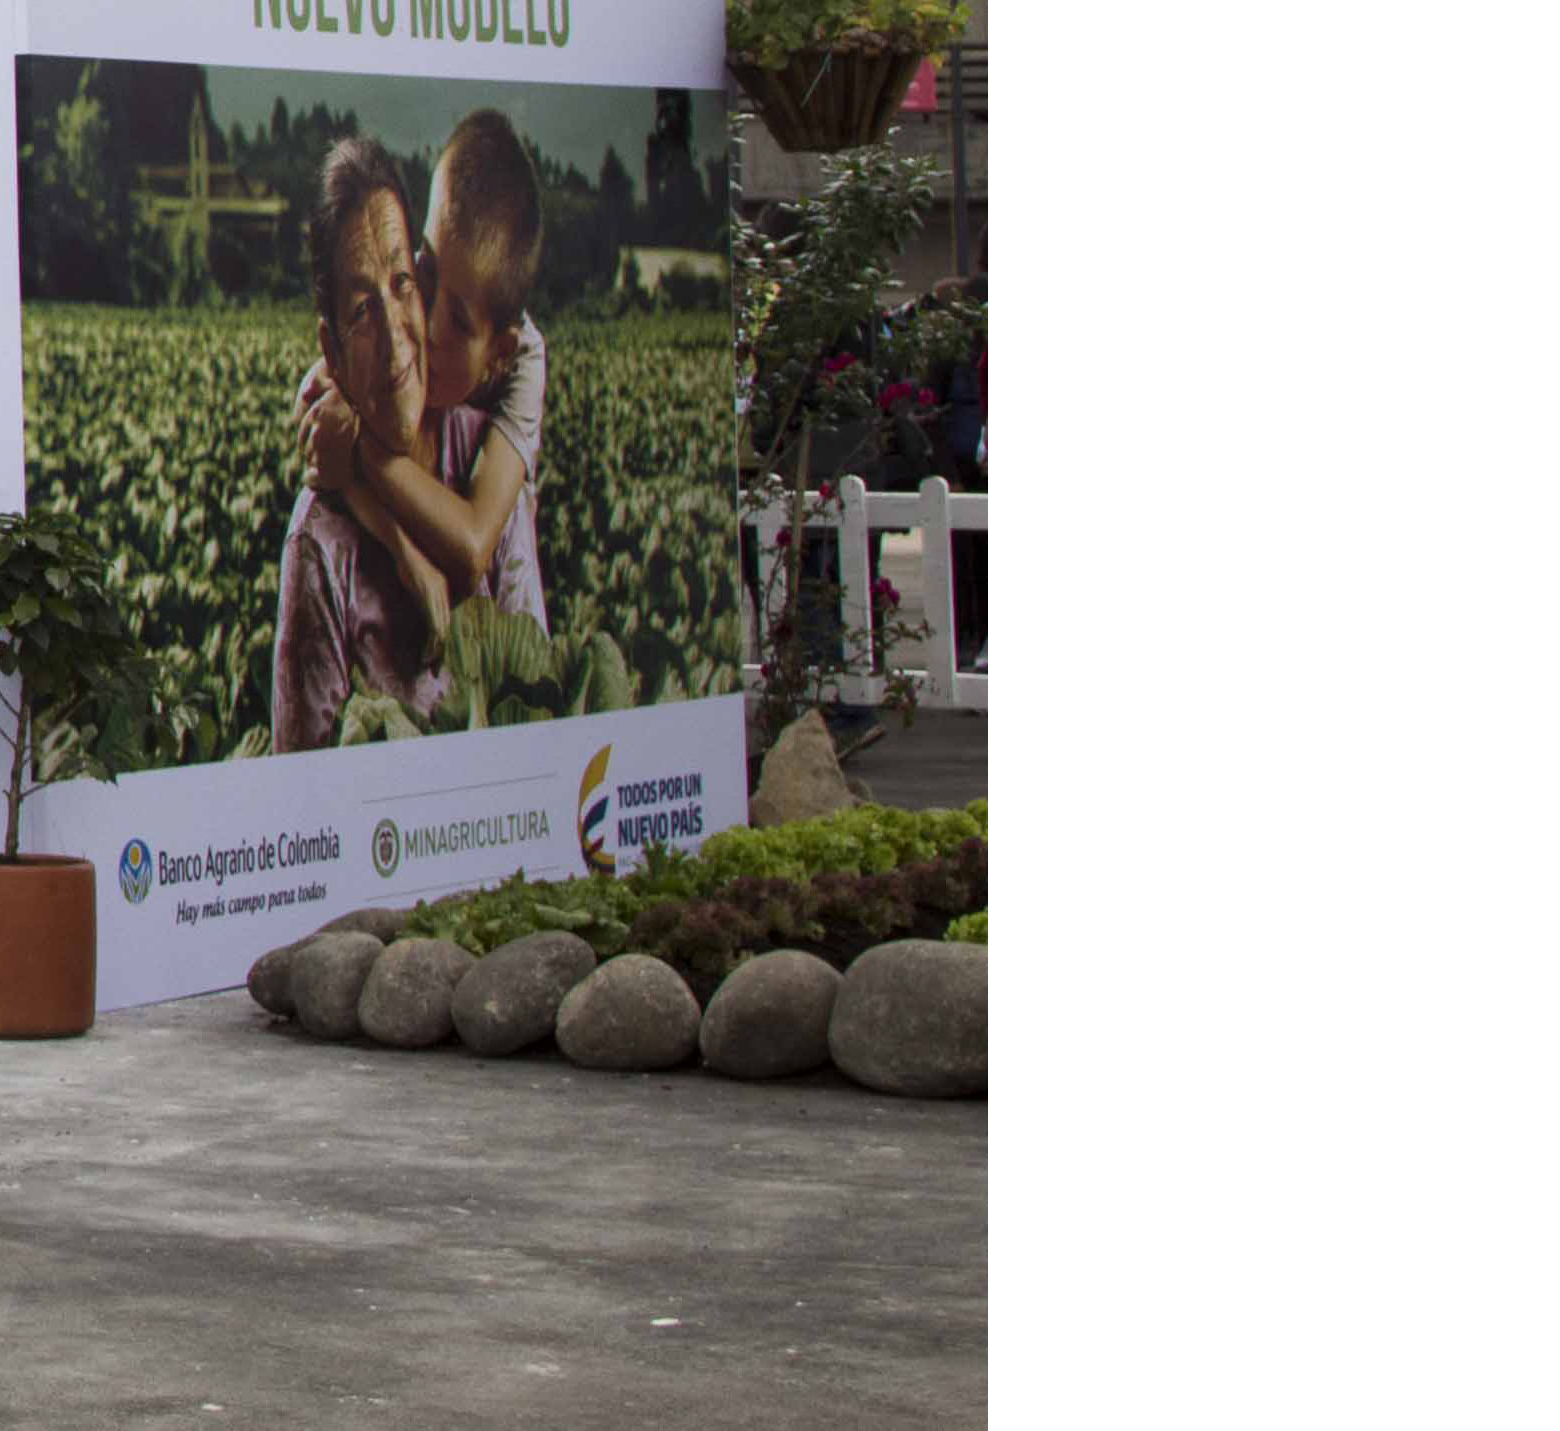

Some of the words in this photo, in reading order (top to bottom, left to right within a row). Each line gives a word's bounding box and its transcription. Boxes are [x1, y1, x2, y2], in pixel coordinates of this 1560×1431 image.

[616, 779, 658, 809] TODOS
[658, 775, 683, 802] POR
[684, 772, 702, 798] UN
[404, 808, 550, 861] MINAGRICULTURA
[617, 812, 669, 848] NUEVO
[670, 801, 703, 839] PAÍS
[158, 849, 202, 887] Banco
[204, 837, 255, 886] Agrario
[257, 834, 275, 871] de
[277, 824, 340, 869] Colombia
[176, 897, 201, 926] Hay
[201, 894, 226, 920] más
[227, 891, 266, 916] campo
[268, 888, 296, 913] para
[297, 879, 327, 905] todos
